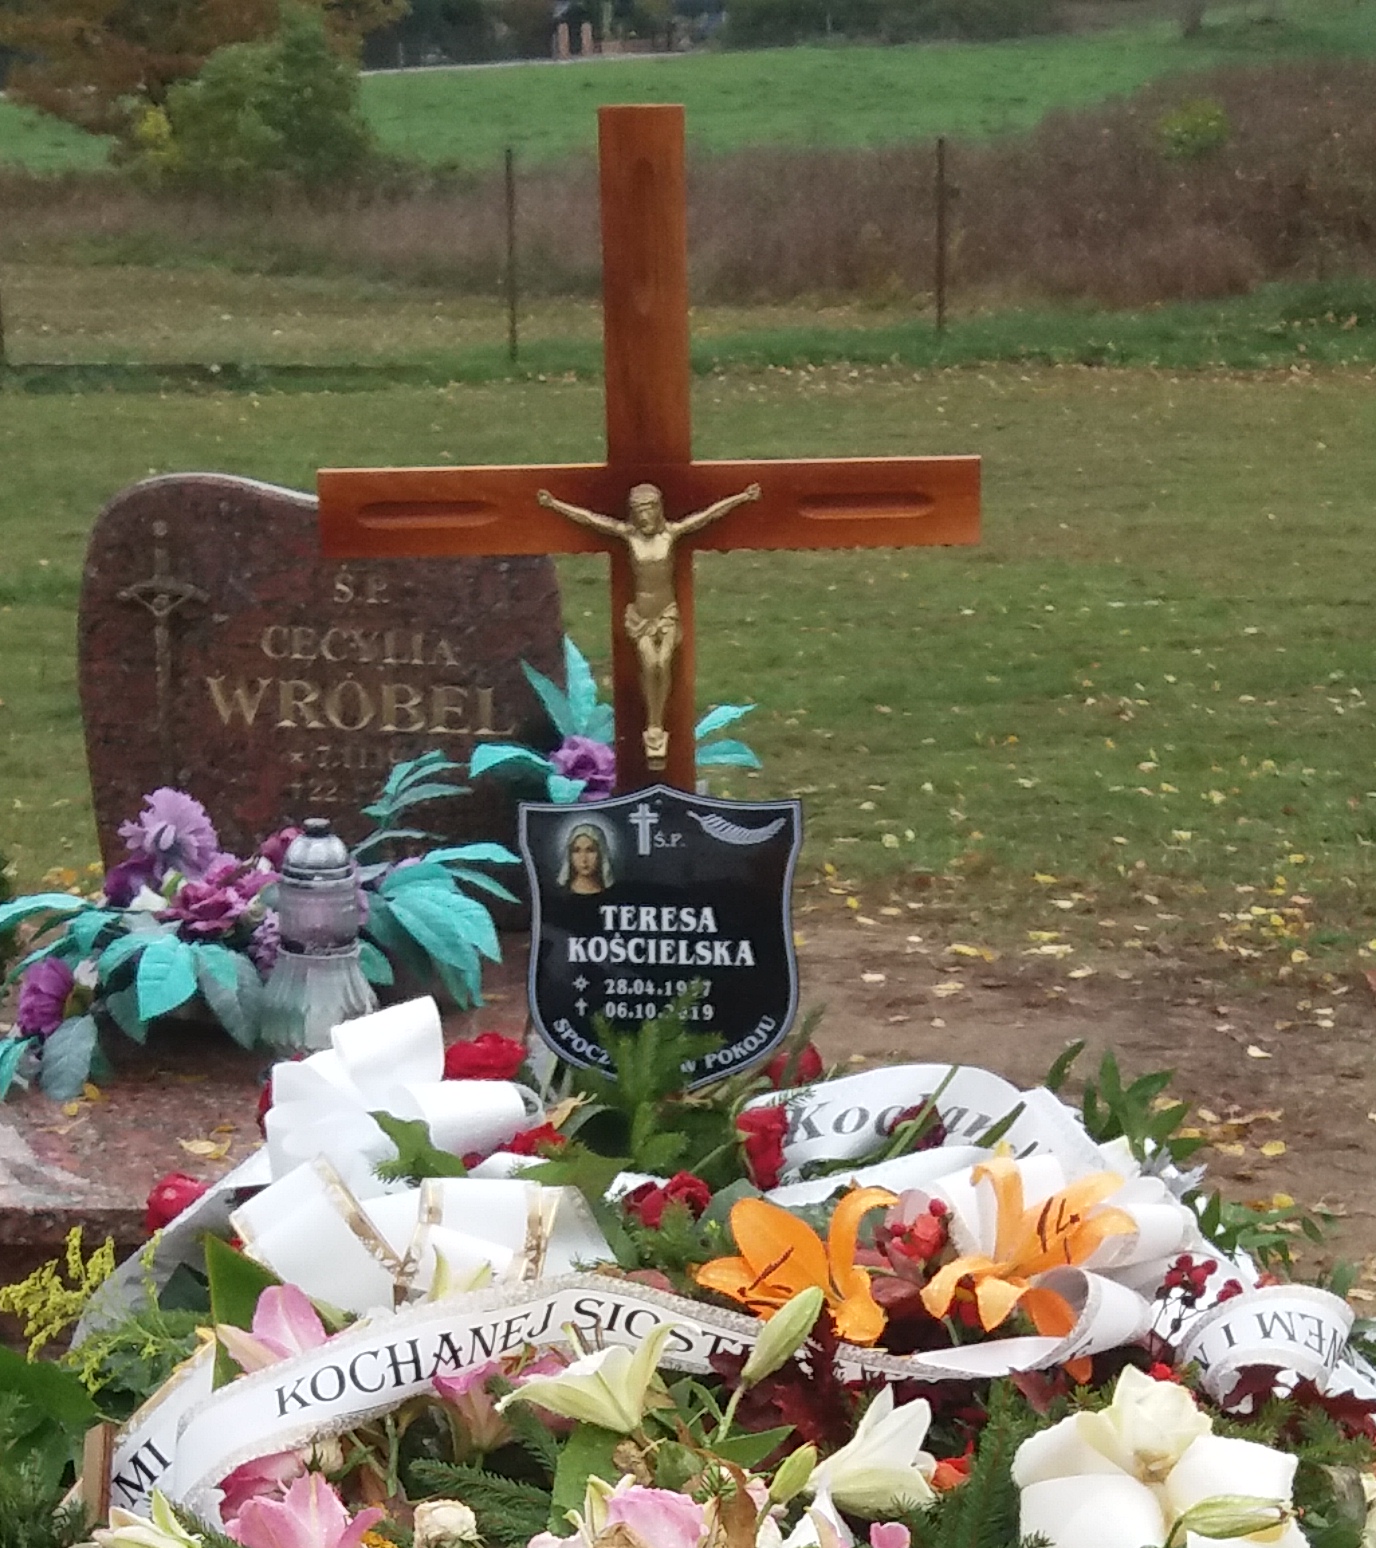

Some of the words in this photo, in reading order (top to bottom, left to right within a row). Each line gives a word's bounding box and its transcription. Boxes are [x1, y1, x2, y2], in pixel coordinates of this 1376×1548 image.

[261, 625, 461, 667] CECYLIA
[207, 670, 515, 736] WRÓBEL
[600, 904, 718, 934] TERESA
[568, 932, 755, 967] KOŚCIELSKA
[704, 1015, 777, 1069] POKOJU
[276, 1300, 556, 1418] KOCHANEJ
